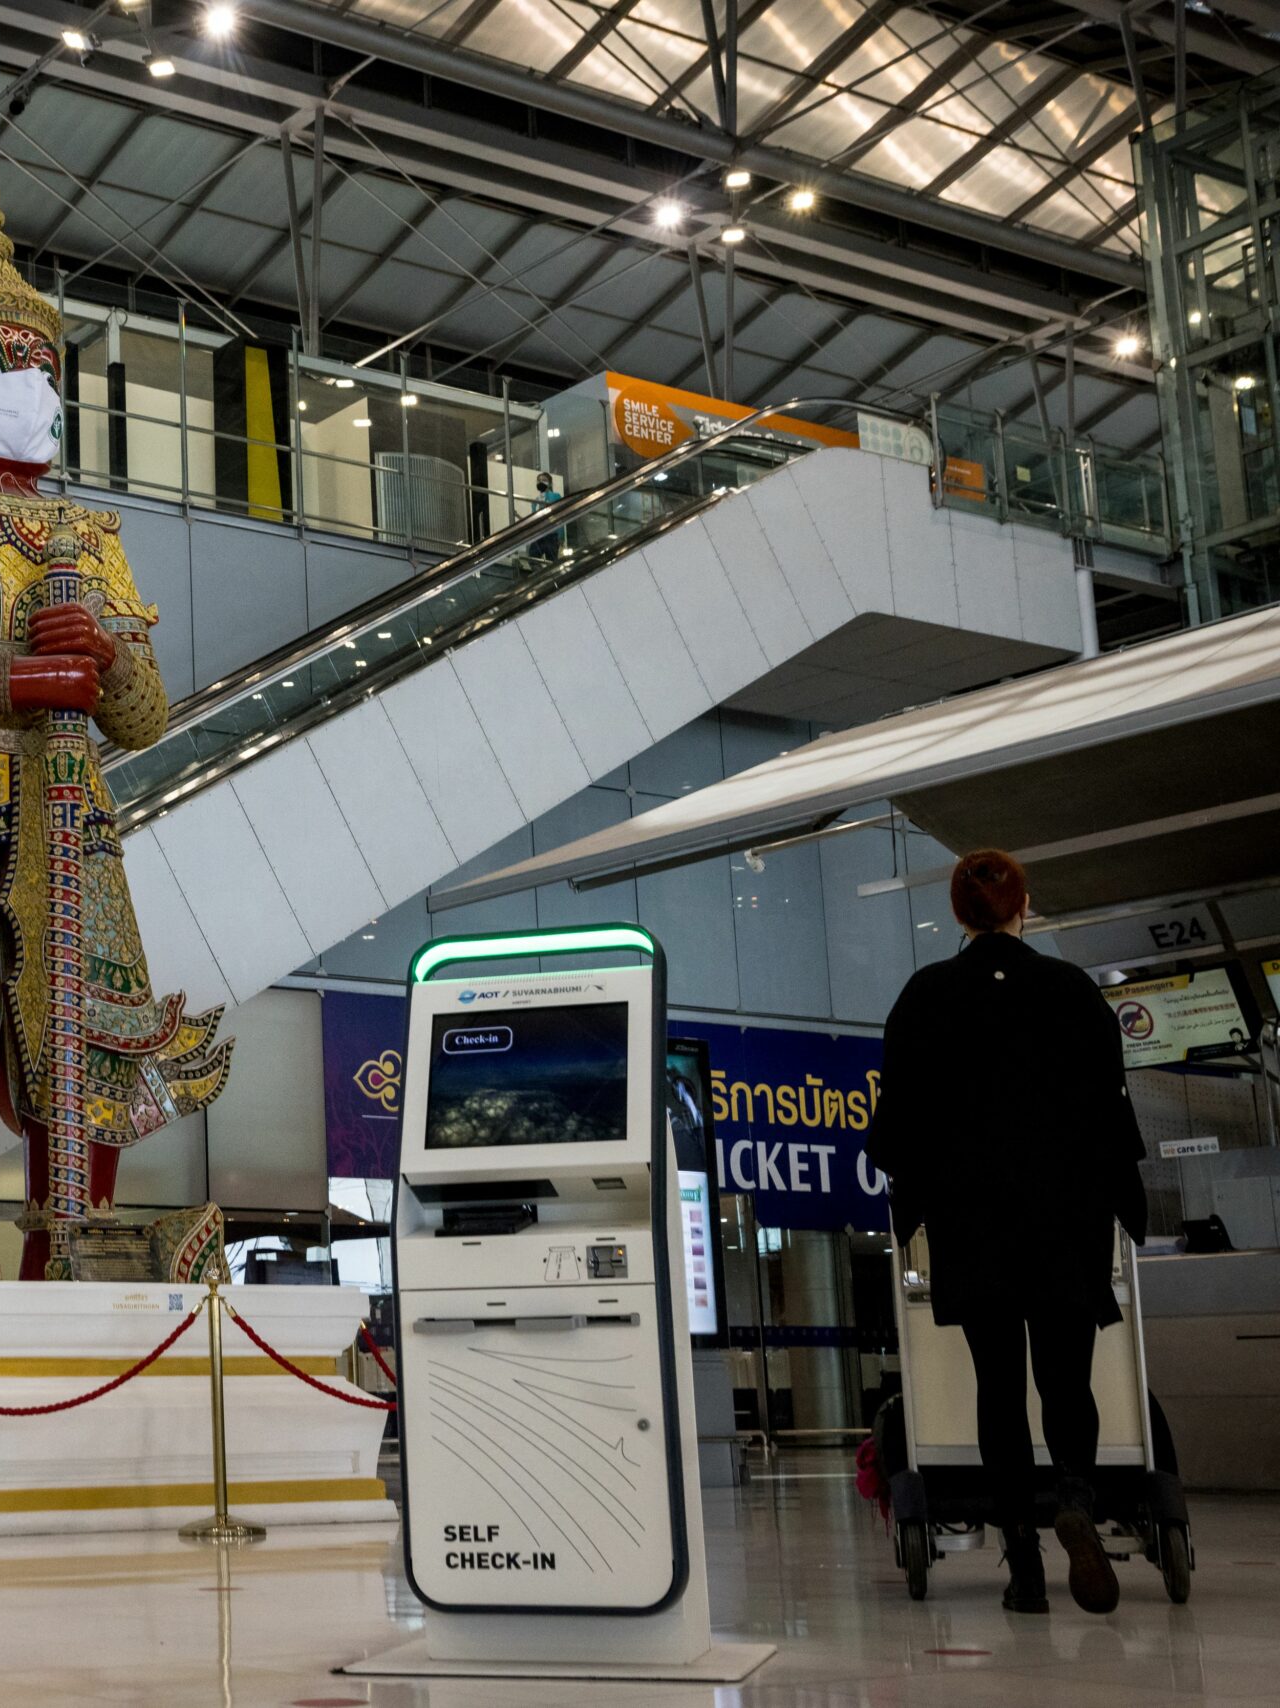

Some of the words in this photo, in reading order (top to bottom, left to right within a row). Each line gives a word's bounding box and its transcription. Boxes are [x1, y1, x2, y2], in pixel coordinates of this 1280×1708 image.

[623, 398, 659, 417] SMILE
[624, 411, 675, 433] SERVICE
[624, 424, 672, 445] CENTER
[1148, 917, 1206, 948] E24
[477, 991, 500, 999] AOT
[512, 986, 582, 997] SUVARNABHUMI
[1104, 989, 1123, 998] Dear
[1125, 981, 1175, 995] Passengers
[455, 1033, 499, 1046] Check-in
[711, 1069, 881, 1131] ริการบัตรโ
[715, 1138, 836, 1194] ICKET
[444, 1525, 500, 1543] SELF
[445, 1552, 556, 1570] CHECK-IN
